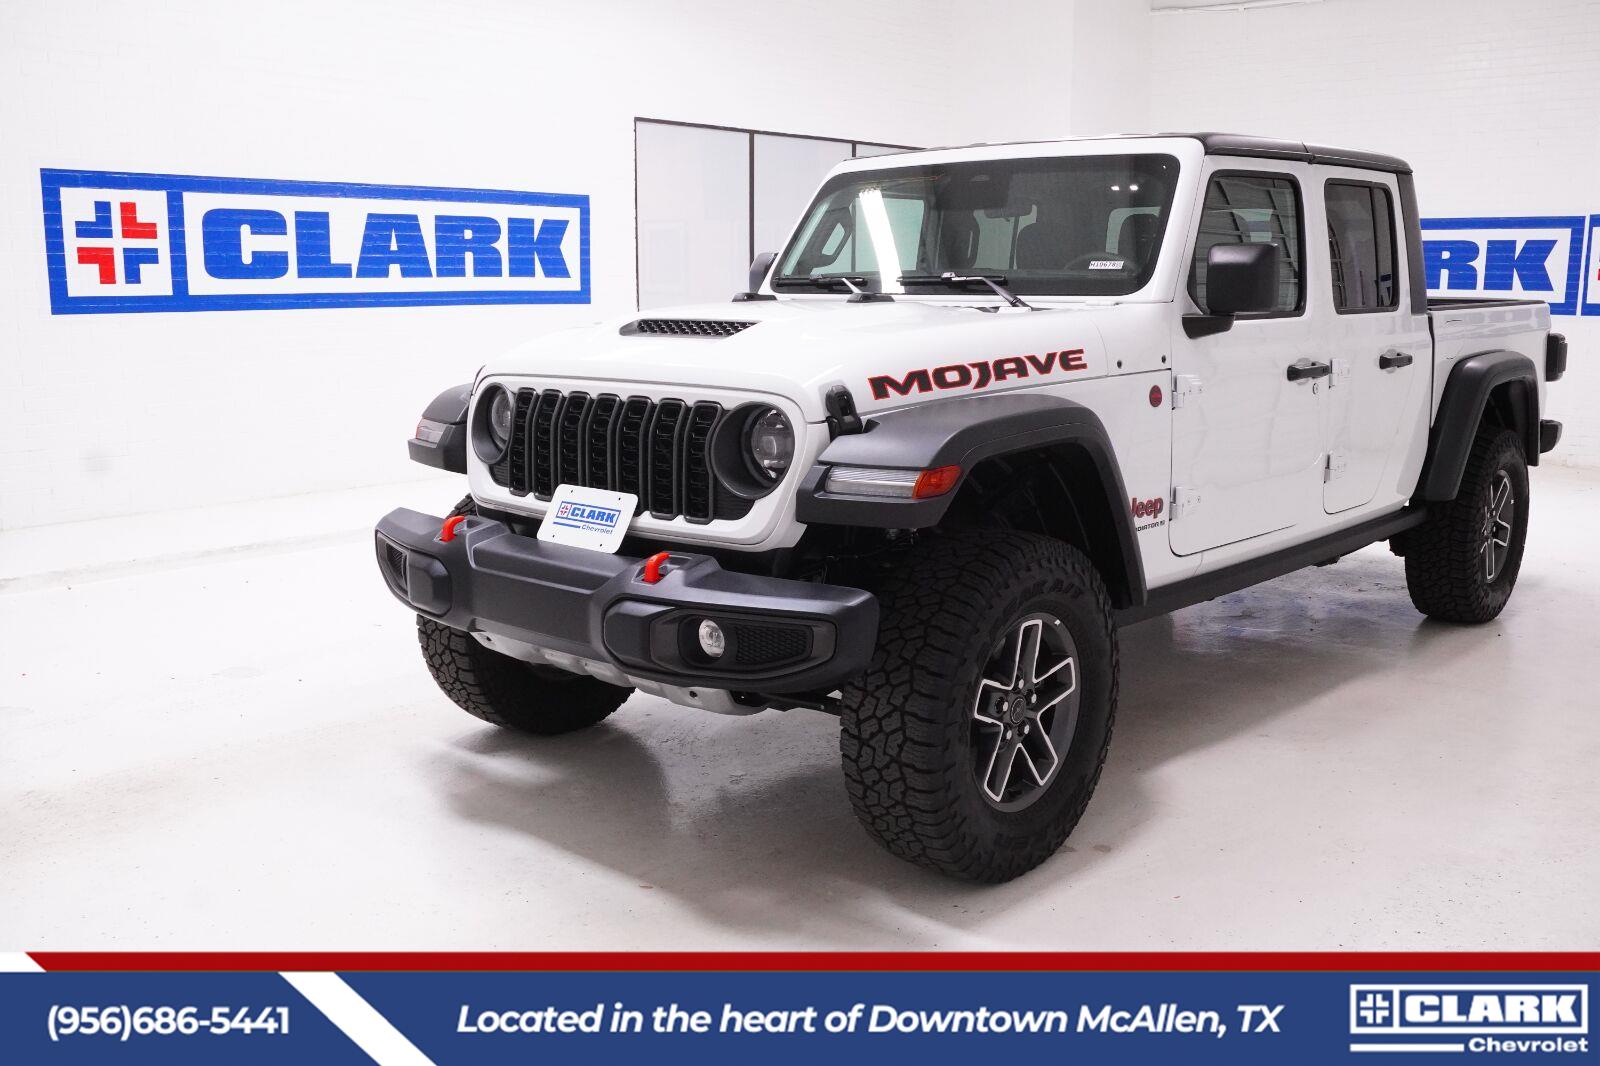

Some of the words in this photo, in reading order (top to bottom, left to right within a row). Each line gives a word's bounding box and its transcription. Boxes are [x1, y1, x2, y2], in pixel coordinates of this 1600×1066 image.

[202, 208, 571, 280] CLARK
[868, 348, 1088, 400] MOJAVE
[570, 506, 617, 523] CLARK
[581, 524, 613, 535] Chevrolet
[1135, 521, 1160, 531] DIATOR
